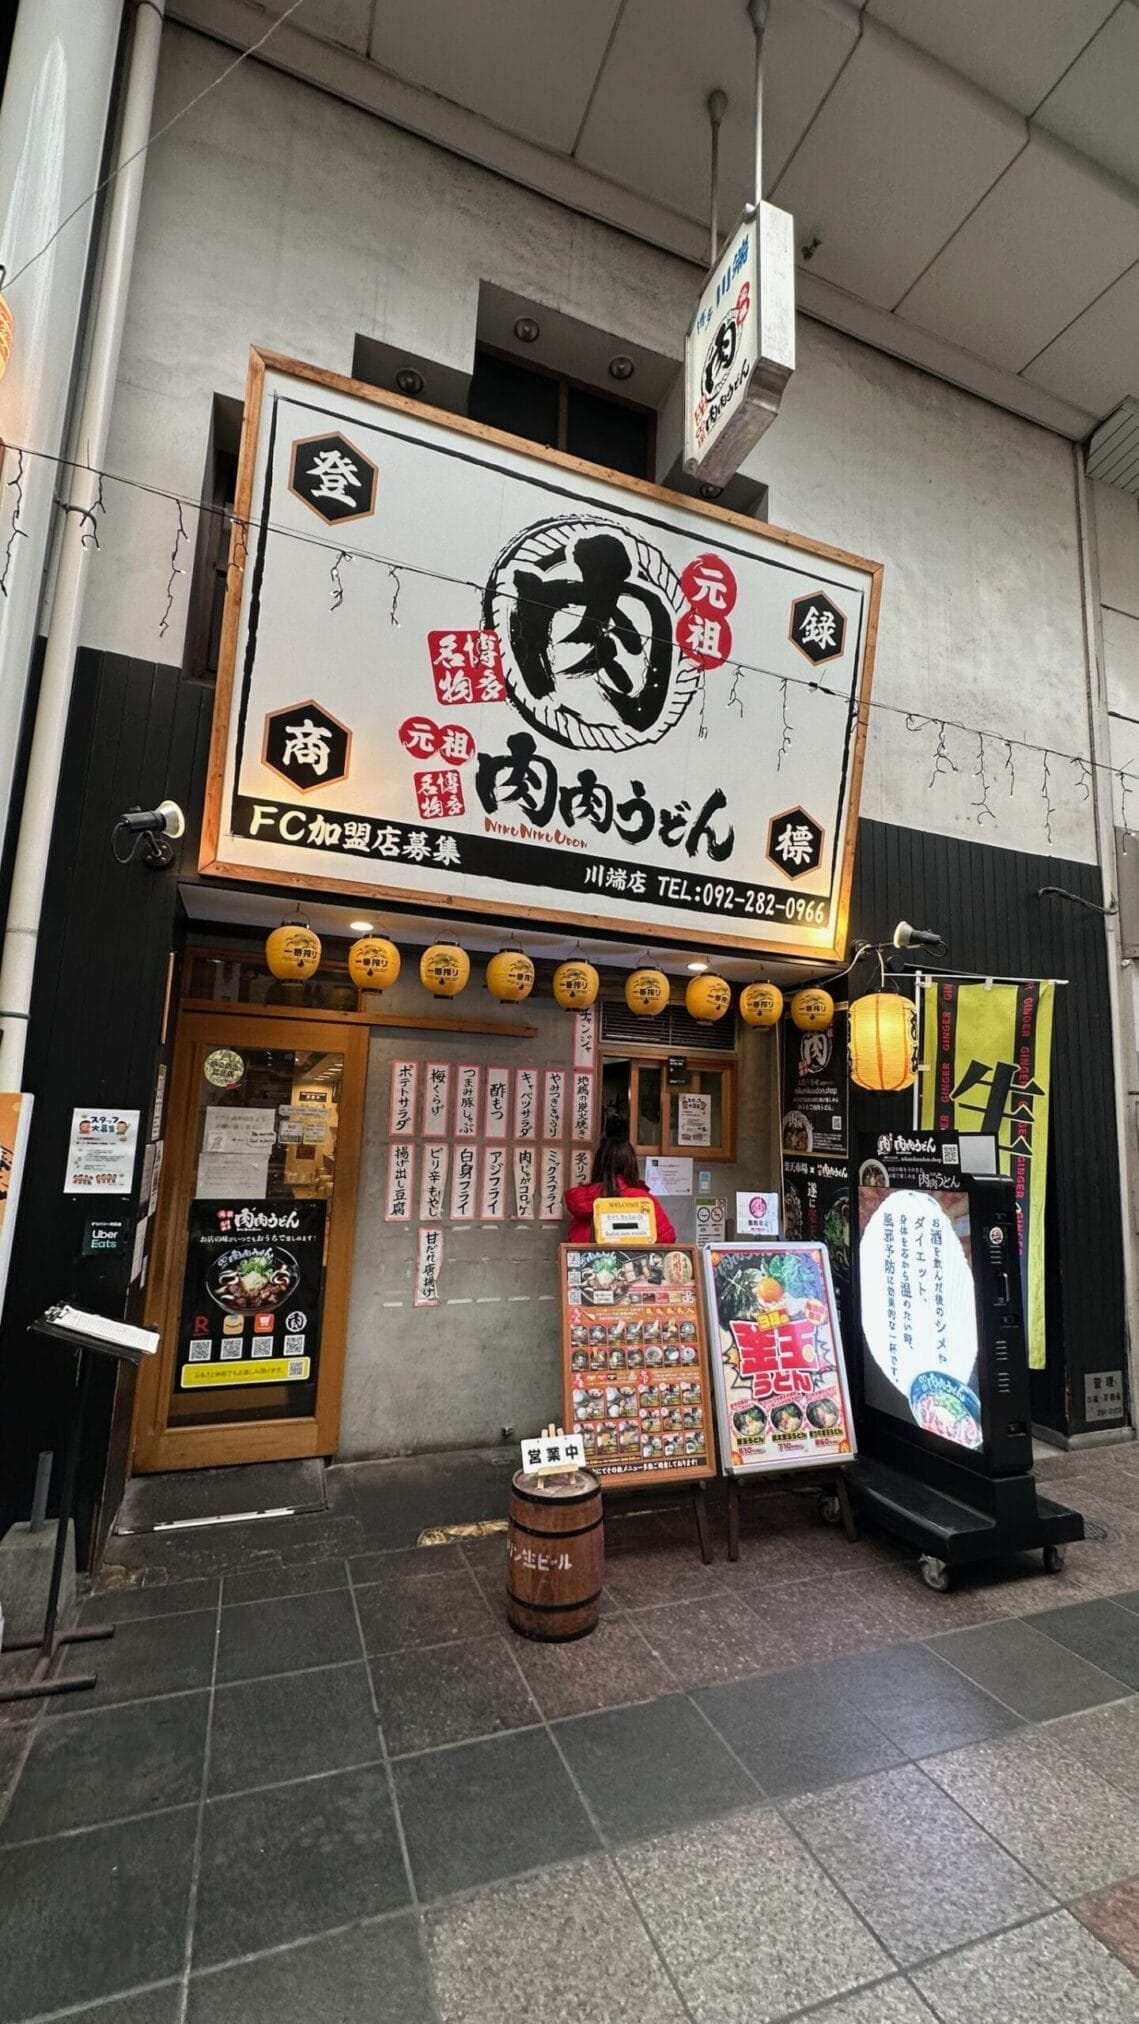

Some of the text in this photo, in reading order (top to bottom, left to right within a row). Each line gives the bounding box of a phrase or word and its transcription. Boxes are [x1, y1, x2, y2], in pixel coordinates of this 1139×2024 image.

[307, 449, 360, 508] 登
[508, 533, 674, 733] 肉
[685, 566, 728, 660] 元祖
[799, 611, 837, 648] 録
[281, 720, 331, 776] 商
[406, 722, 471, 762] 元祖
[475, 731, 735, 861] 肉肉うどん
[249, 804, 463, 867] FC加盟店募集
[775, 823, 812, 866] 標
[584, 863, 825, 924] 川端店 TEL:092-282-0966
[942, 1011, 951, 1051] GINGER
[1022, 998, 1034, 1038] GINGER
[395, 1065, 414, 1131] ポテトサラダ
[429, 1069, 447, 1117] 梅くらげ
[459, 1069, 475, 1134] つまみ豚しゃぶ
[489, 1083, 506, 1120] 酢もつ
[520, 1071, 534, 1138] キャベツサラダ
[549, 1073, 562, 1138] やみつききゅうり
[575, 1075, 590, 1140] 地鶏の炭火焼き
[940, 1063, 950, 1103] GINGER
[90, 1116, 120, 1124] スタッフ
[390, 1146, 410, 1217] 揚げ出し豆腐
[428, 1147, 443, 1217] ピリ辛もやし
[457, 1149, 474, 1215] 白身フライ
[488, 1151, 503, 1215] アジフライ
[519, 1150, 532, 1216] 肉じゃがコロッケ
[546, 1150, 561, 1215] ミックスフライ
[1015, 1156, 1025, 1199] GINGER
[91, 1240, 118, 1249] Eats
[92, 1230, 118, 1239] Uber
[234, 1206, 300, 1229] 肉肉うどん
[422, 1231, 439, 1297] 甘だれ唐揚げ
[753, 1373, 813, 1397] うどん
[527, 1443, 579, 1465] 営業中
